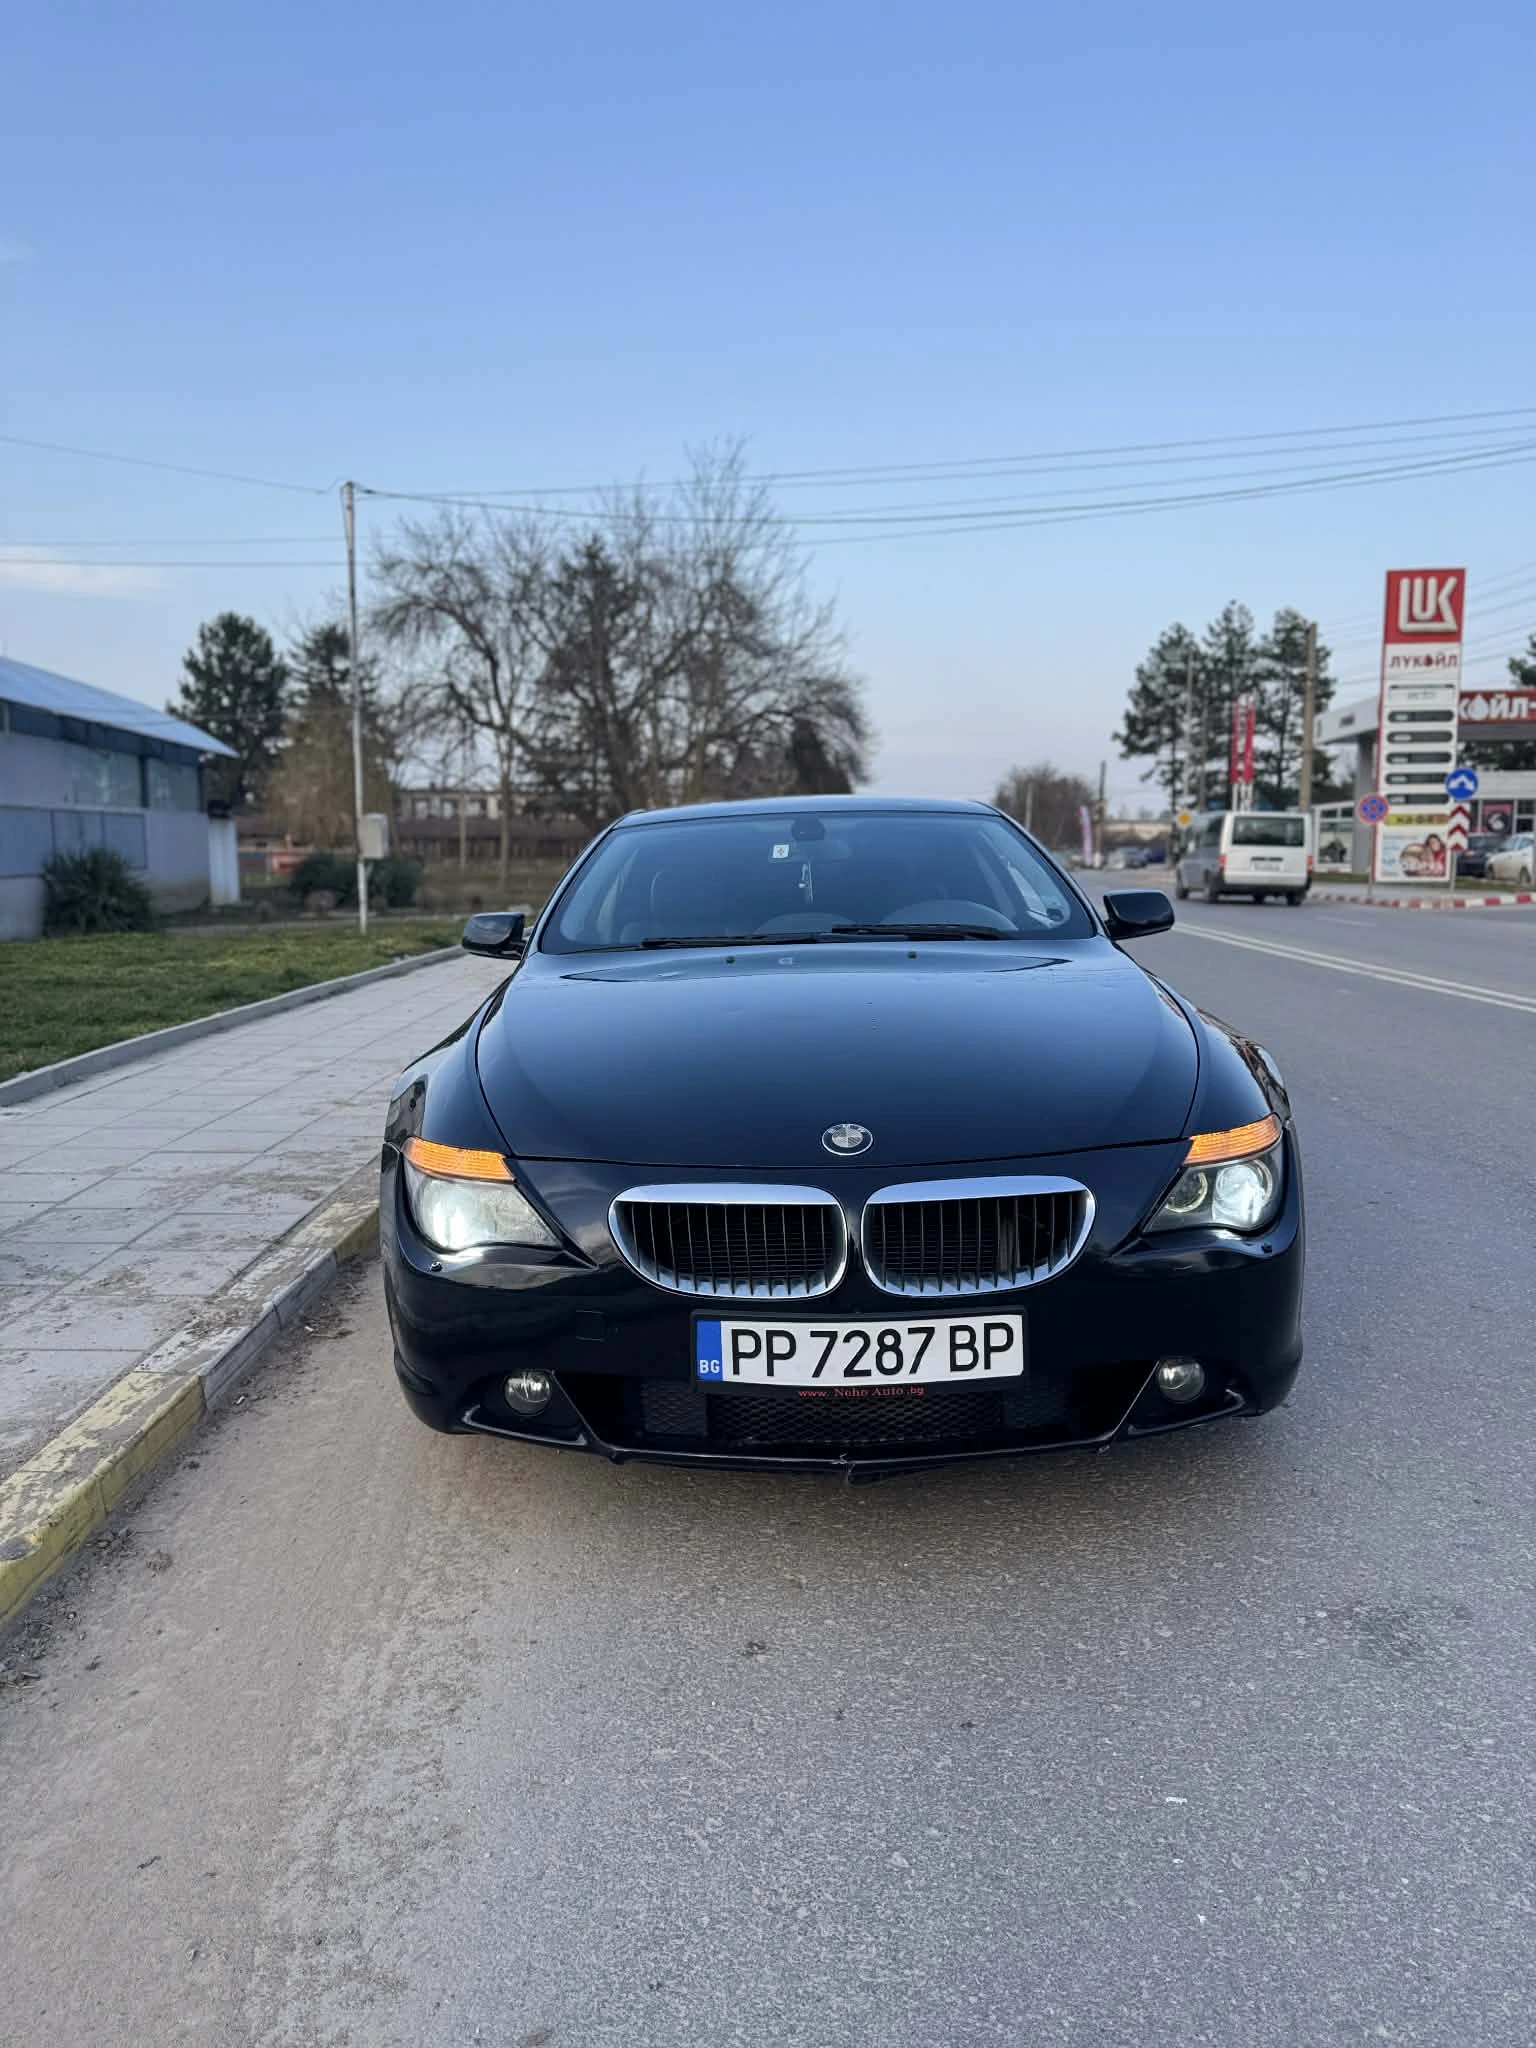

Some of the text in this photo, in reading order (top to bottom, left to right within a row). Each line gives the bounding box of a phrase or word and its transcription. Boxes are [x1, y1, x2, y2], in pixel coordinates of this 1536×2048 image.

[699, 1359, 720, 1375] BG
[731, 1322, 1014, 1378] PP 7287 BP
